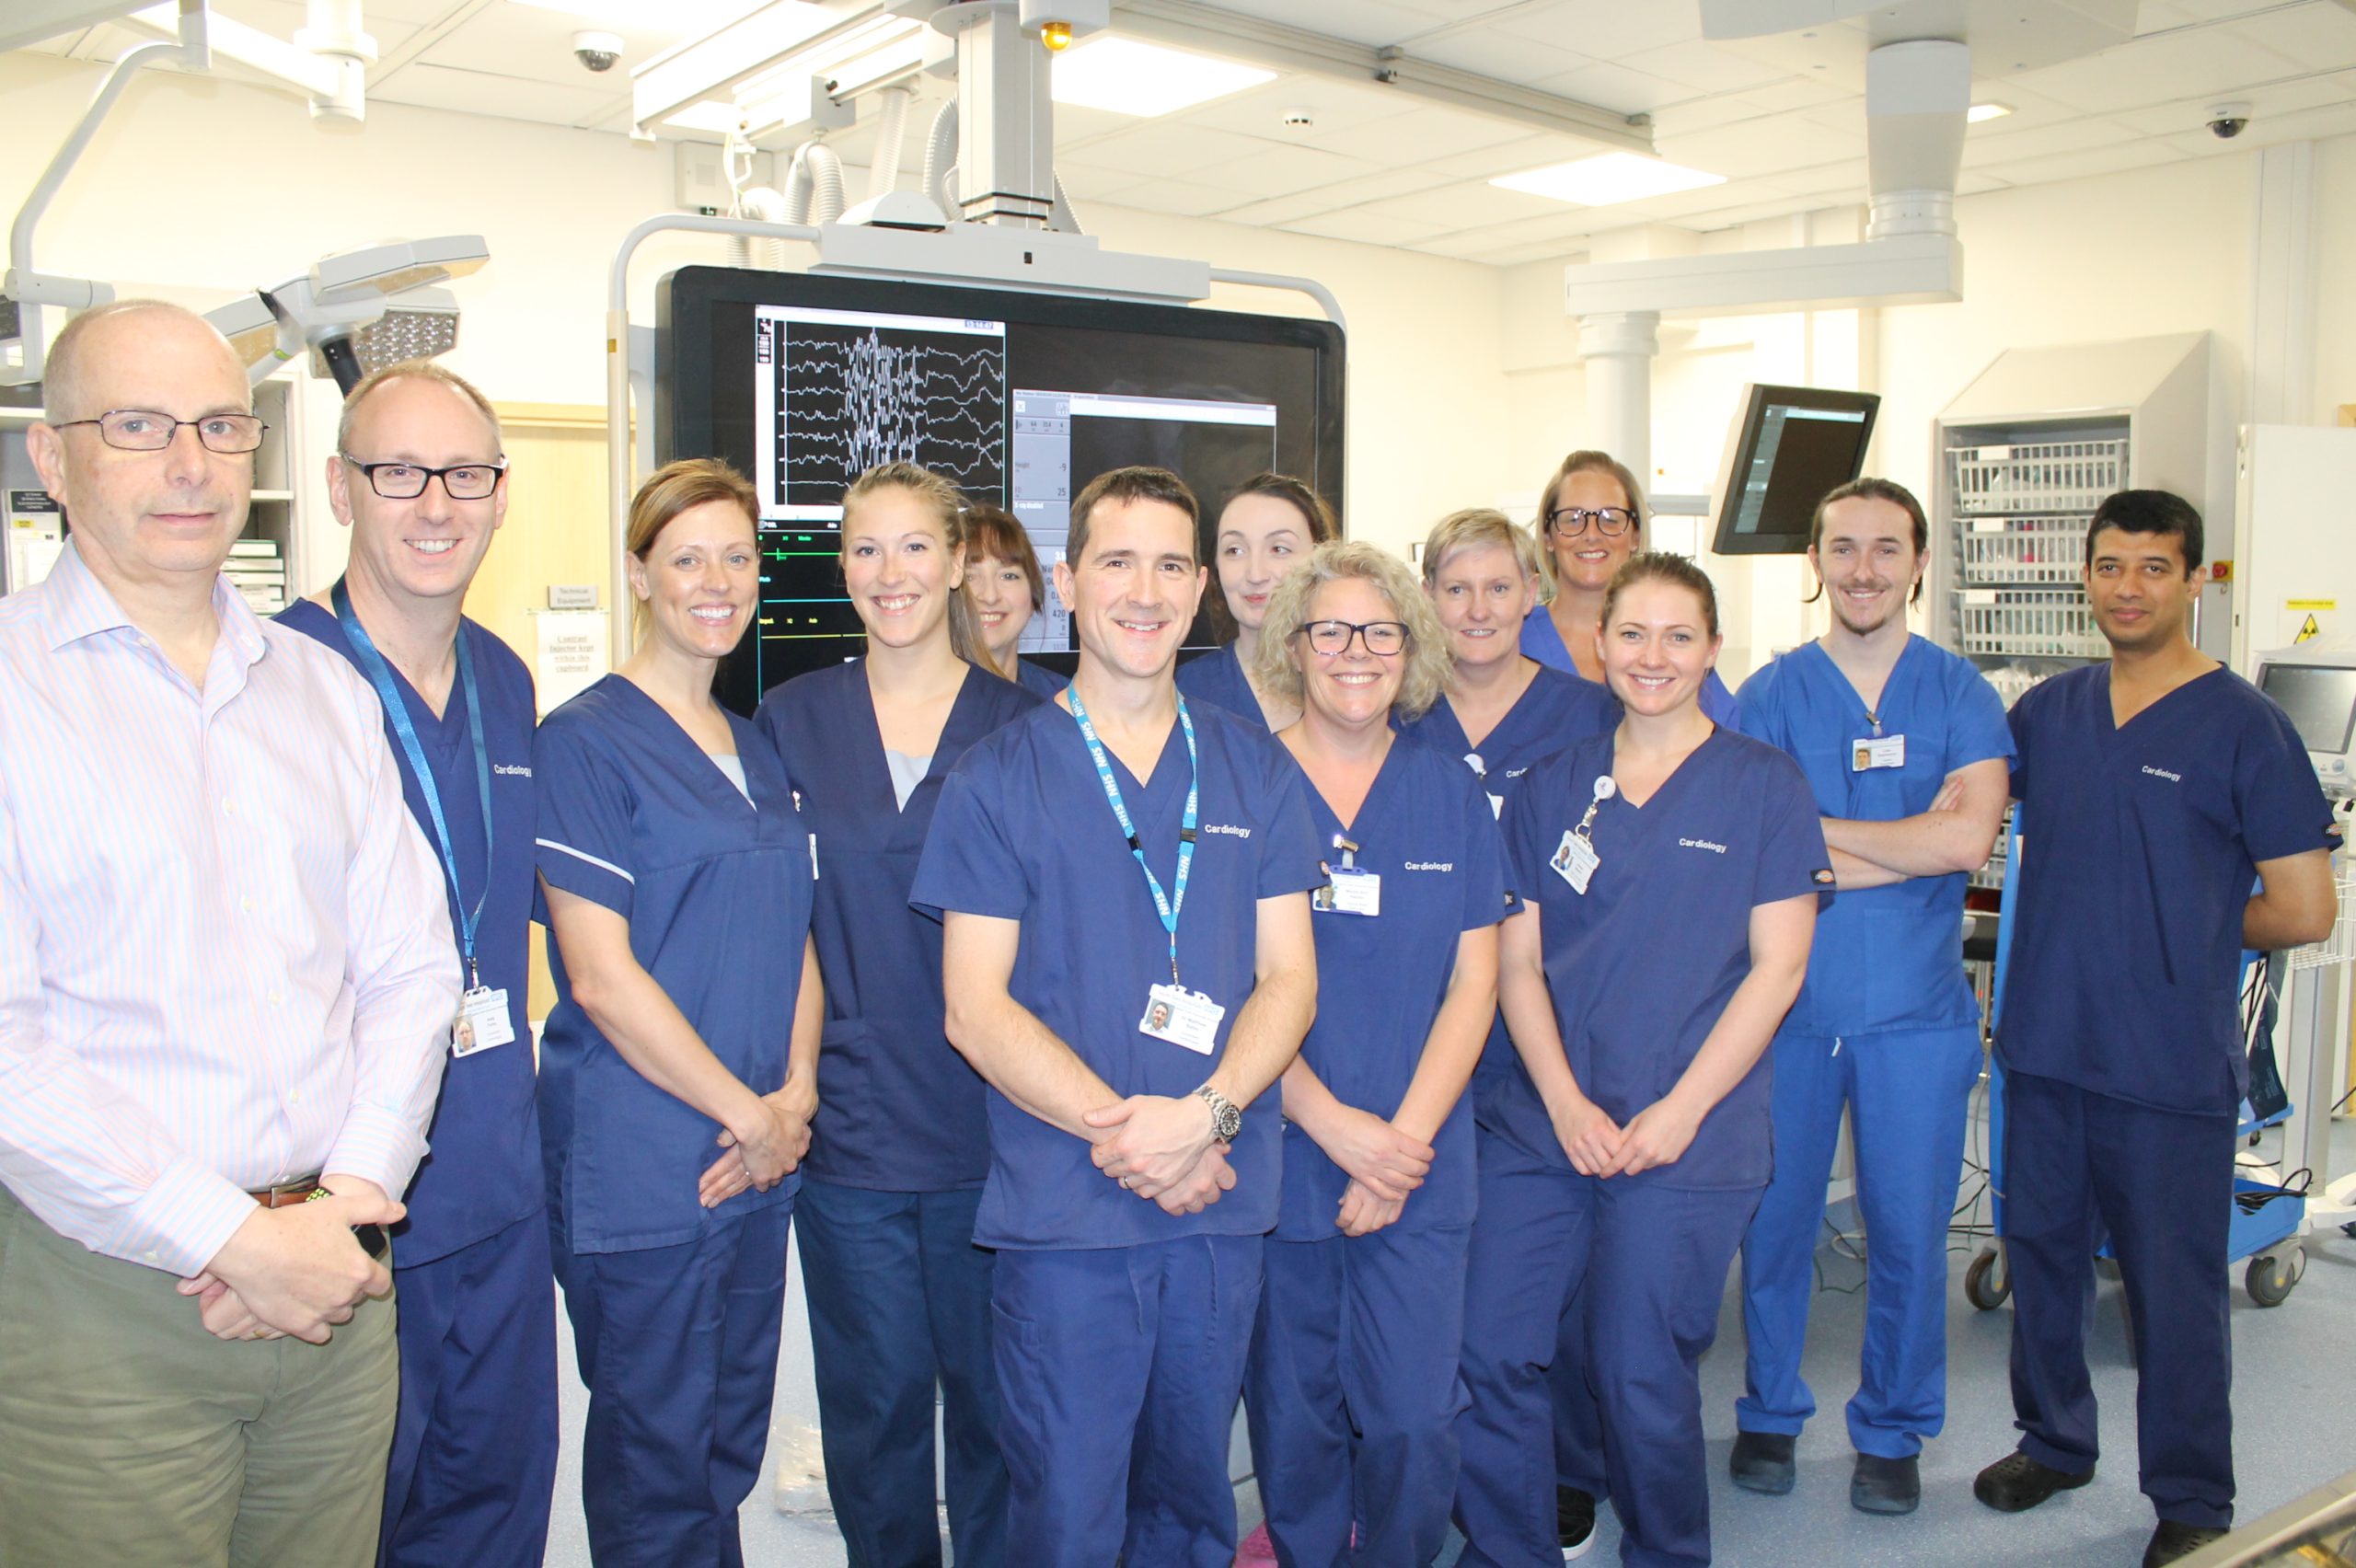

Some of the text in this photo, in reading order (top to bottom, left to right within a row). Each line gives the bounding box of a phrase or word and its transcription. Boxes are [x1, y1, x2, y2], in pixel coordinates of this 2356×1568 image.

[1057, 487, 1067, 497] 25
[557, 597, 592, 605] Equipment
[1052, 609, 1066, 618] 420
[1080, 721, 1098, 742] NHS
[1091, 745, 1109, 769] NHS
[2142, 765, 2182, 782] Cardiology
[1102, 773, 1119, 798] NHS
[1113, 802, 1130, 828] NHS
[1204, 823, 1252, 839] Cardiology
[1679, 837, 1727, 854] Cardiology
[1178, 854, 1191, 882] NHS
[1404, 861, 1453, 872] Cardiology
[1154, 892, 1170, 917] NHS
